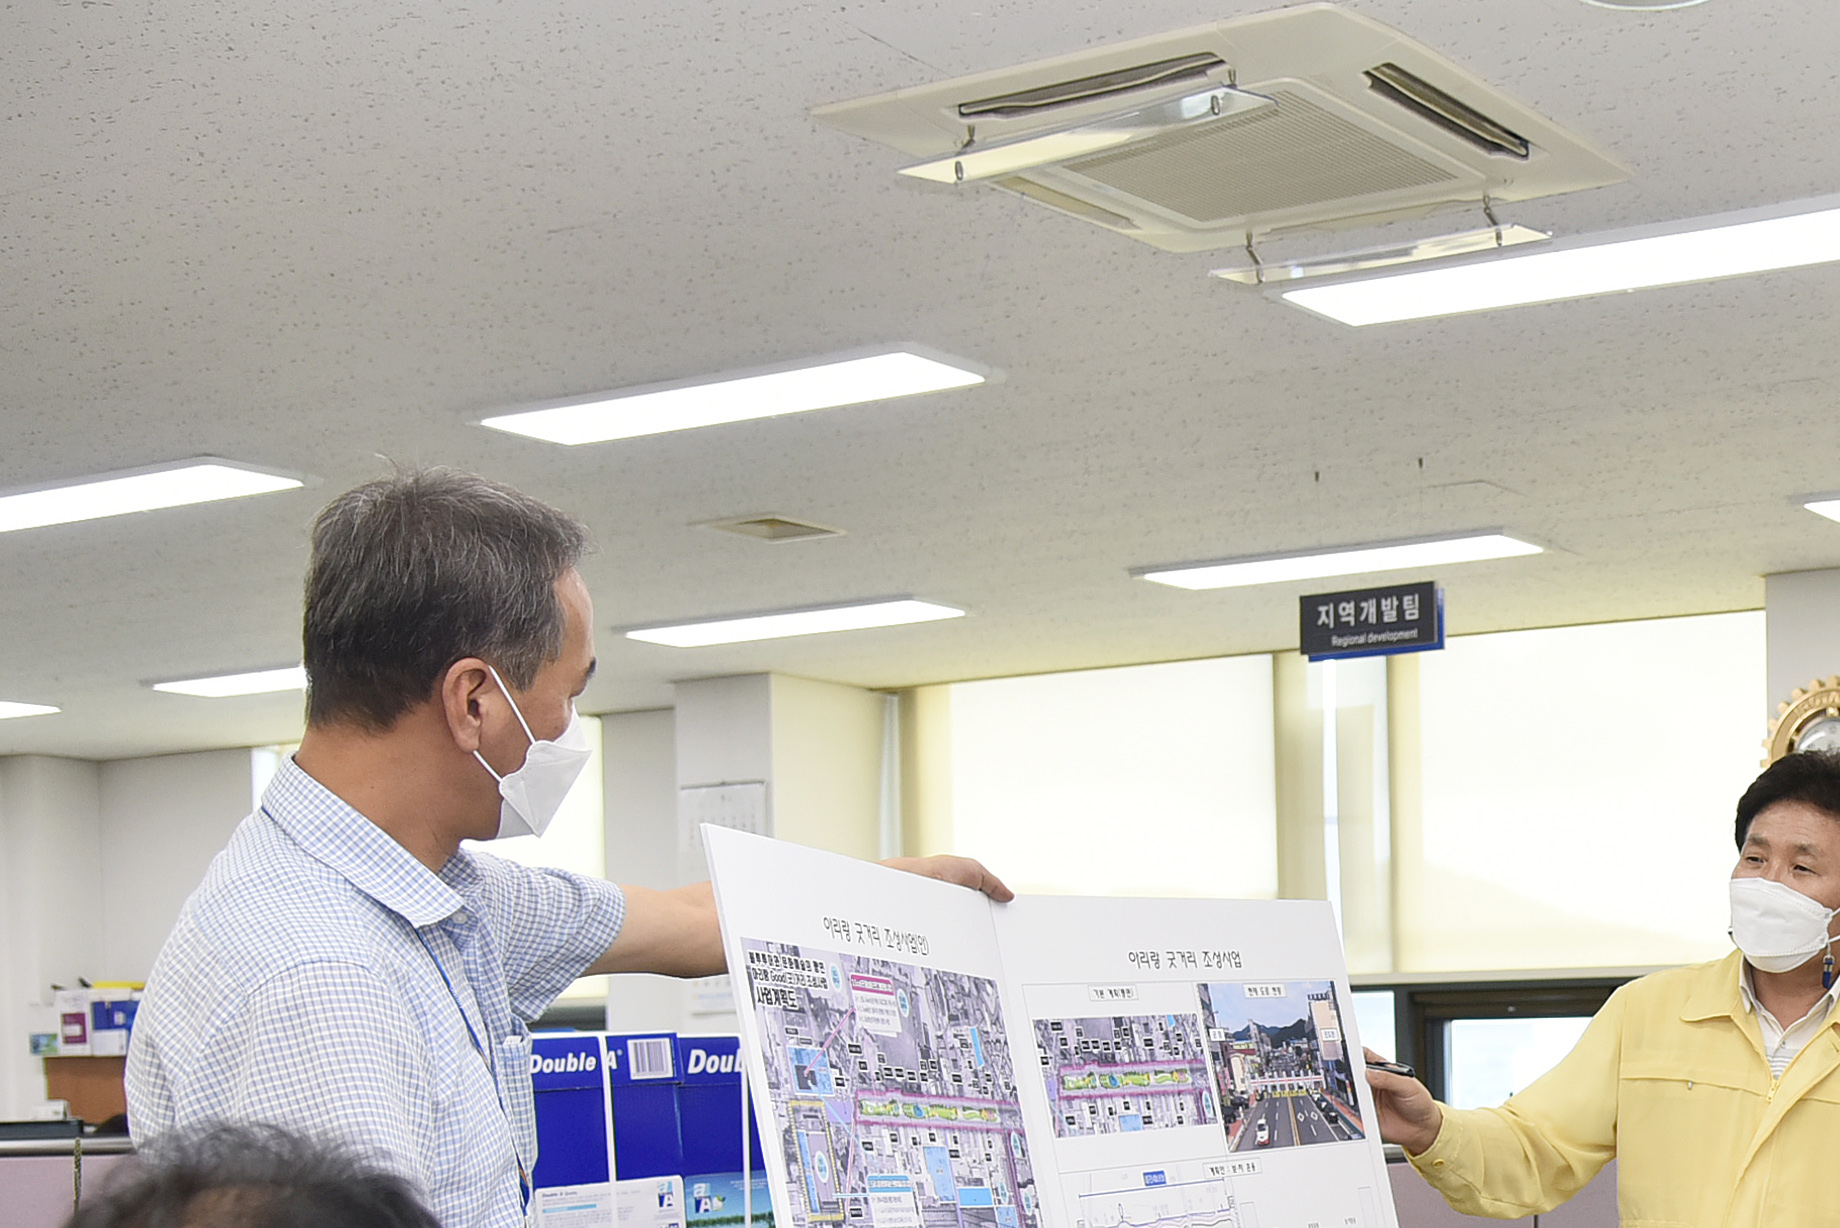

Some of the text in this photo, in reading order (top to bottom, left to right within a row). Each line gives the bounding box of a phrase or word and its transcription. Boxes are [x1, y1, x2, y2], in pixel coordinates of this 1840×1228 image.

[1316, 593, 1420, 629] 지역개발팀
[1331, 628, 1419, 648] Regional development
[823, 916, 930, 956] 아리랑 굿거리 조성사업(안)
[1128, 949, 1243, 970] 아리랑 굿거리 조성사업
[756, 986, 798, 1008] 사업계획도
[530, 1052, 596, 1073] Double
